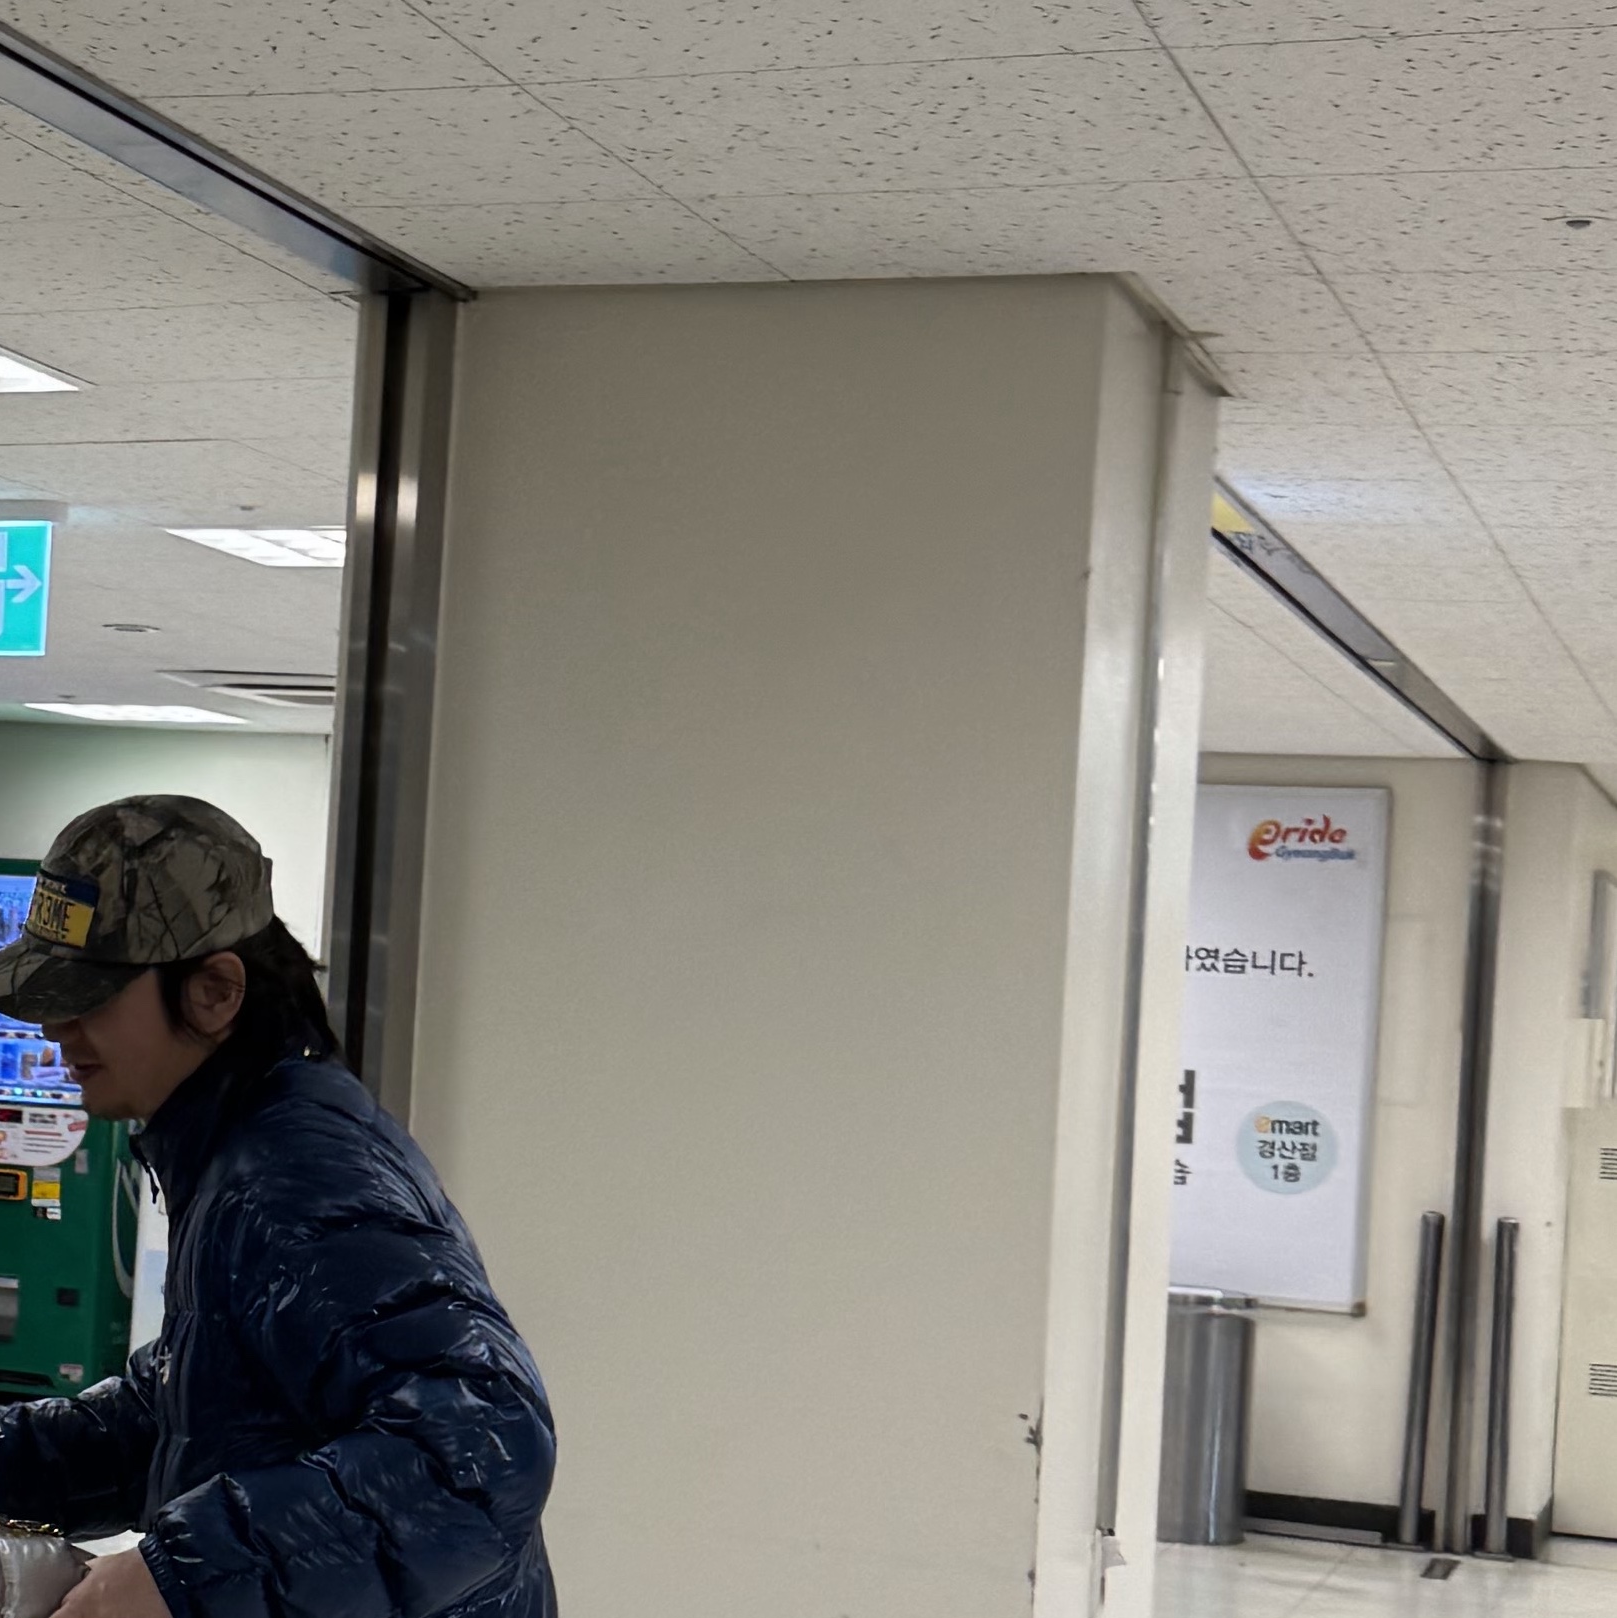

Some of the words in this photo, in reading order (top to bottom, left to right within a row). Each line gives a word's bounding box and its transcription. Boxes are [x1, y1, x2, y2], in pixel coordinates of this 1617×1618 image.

[1254, 1115, 1320, 1137] emart
[1257, 1139, 1318, 1162] 경산점
[1270, 1162, 1301, 1183] 1층
